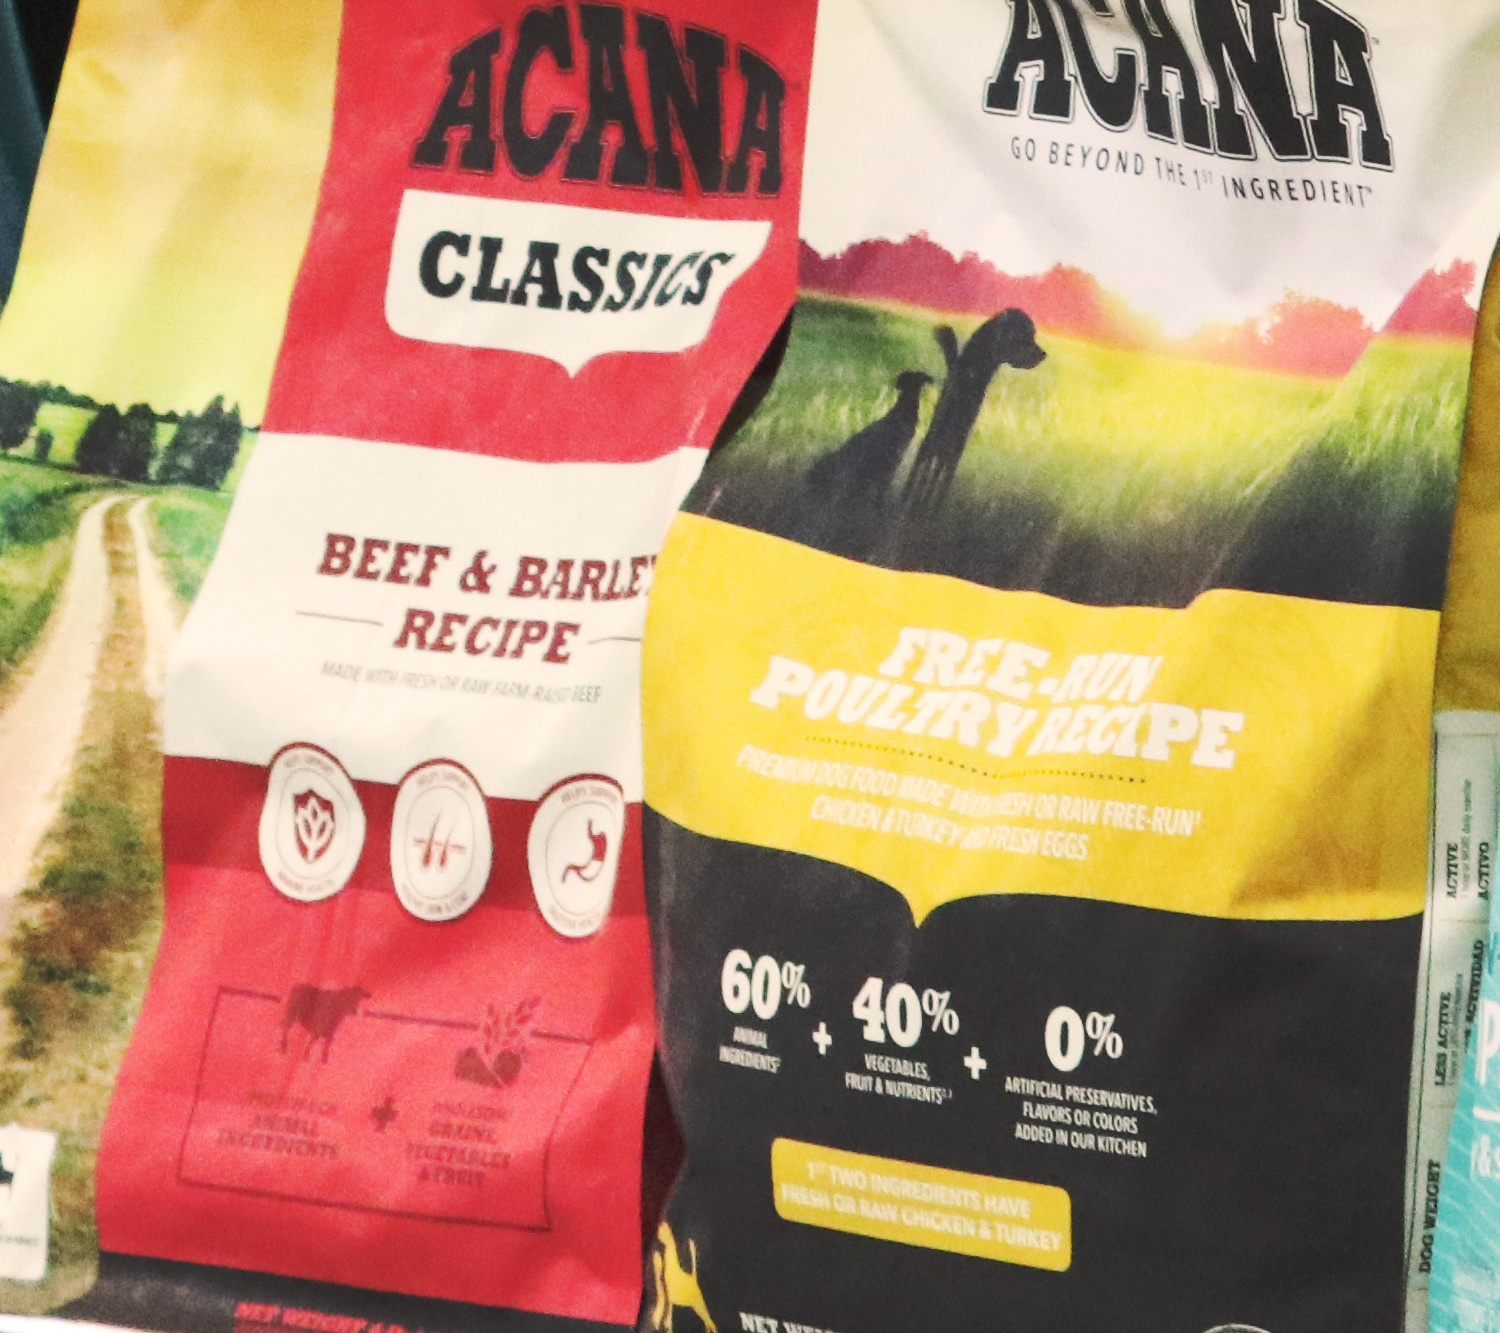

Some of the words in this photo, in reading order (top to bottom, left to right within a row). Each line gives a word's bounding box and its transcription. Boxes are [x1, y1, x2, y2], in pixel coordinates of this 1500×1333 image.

[409, 0, 787, 199] ACANA
[1010, 136, 1037, 160] GO
[1048, 142, 1145, 177] BEYOND
[1153, 155, 1186, 187] THE
[1222, 176, 1368, 208] INGREDIENT
[418, 230, 734, 314] CLASSICS
[317, 533, 451, 587] BEEF
[459, 549, 497, 594] &
[392, 608, 581, 665] RECIPE
[877, 627, 1163, 703] FREE-RUN
[749, 655, 1038, 757] POULTRY
[1026, 700, 1245, 770] RECIPE
[1042, 832, 1090, 862] EGGS
[721, 948, 810, 1020] 60%
[852, 977, 960, 1047] 40%
[1044, 1005, 1123, 1072] 0%
[1005, 1076, 1063, 1102] ARTIFICIAL
[1066, 1085, 1158, 1115] PRESERVATIVES,
[1022, 1101, 1072, 1125] FLAVORS
[1073, 1108, 1092, 1128] OR
[1093, 1111, 1139, 1135] COLORS
[830, 1166, 869, 1191] TWO
[871, 1174, 981, 1212] INGREDIENTS
[983, 1196, 1031, 1221] HAVE
[1480, 1147, 1494, 1179] &
[780, 1183, 831, 1211] FRESH
[833, 1191, 857, 1215] OR
[858, 1197, 898, 1223] RAW
[902, 1205, 976, 1237] CHICKEN
[980, 1219, 993, 1240] &
[994, 1221, 1062, 1252] TURKEY
